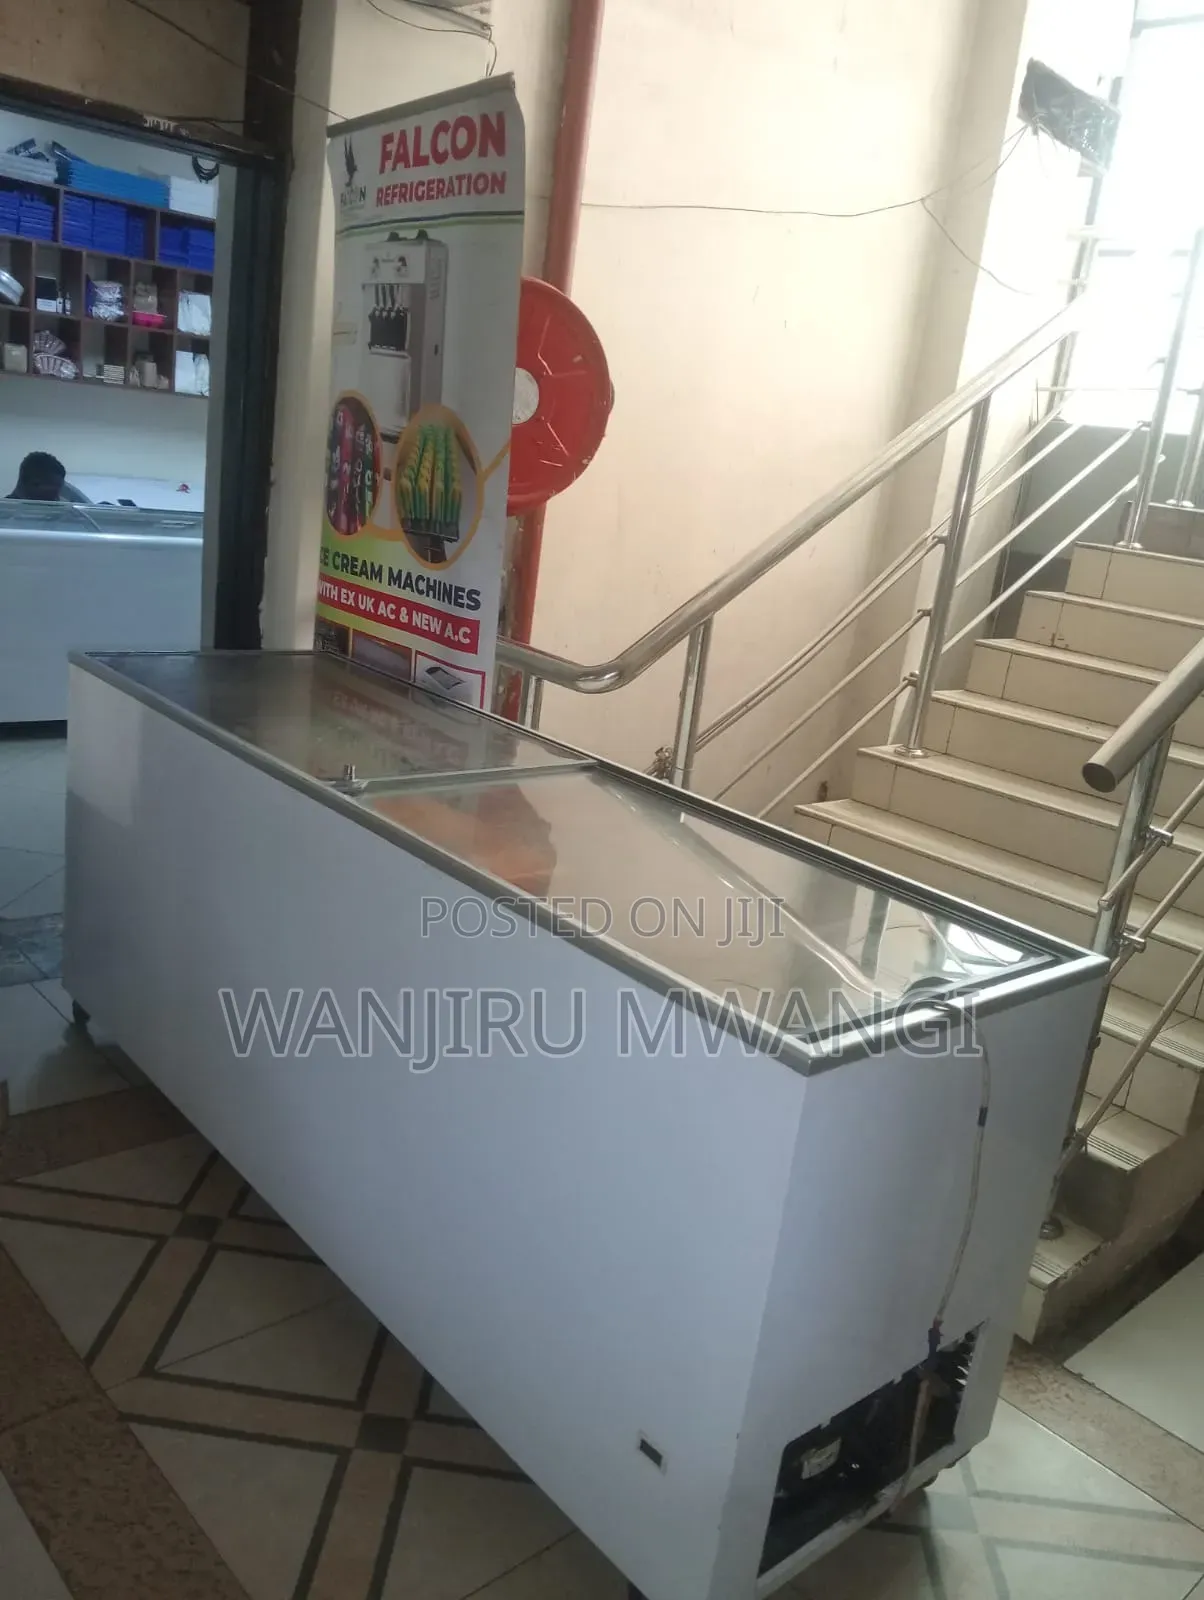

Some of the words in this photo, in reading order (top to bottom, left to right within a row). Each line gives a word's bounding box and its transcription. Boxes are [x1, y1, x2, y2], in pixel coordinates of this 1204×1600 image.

[379, 111, 506, 175] FALCON
[376, 171, 507, 208] REFRIGERATION
[332, 551, 383, 584] CREAM
[387, 569, 481, 611] MACHINES
[340, 587, 356, 607] EX
[358, 593, 375, 614] UK
[377, 600, 396, 620] AC
[399, 607, 409, 624] &
[412, 611, 443, 635] NEW
[444, 622, 471, 645] A.C
